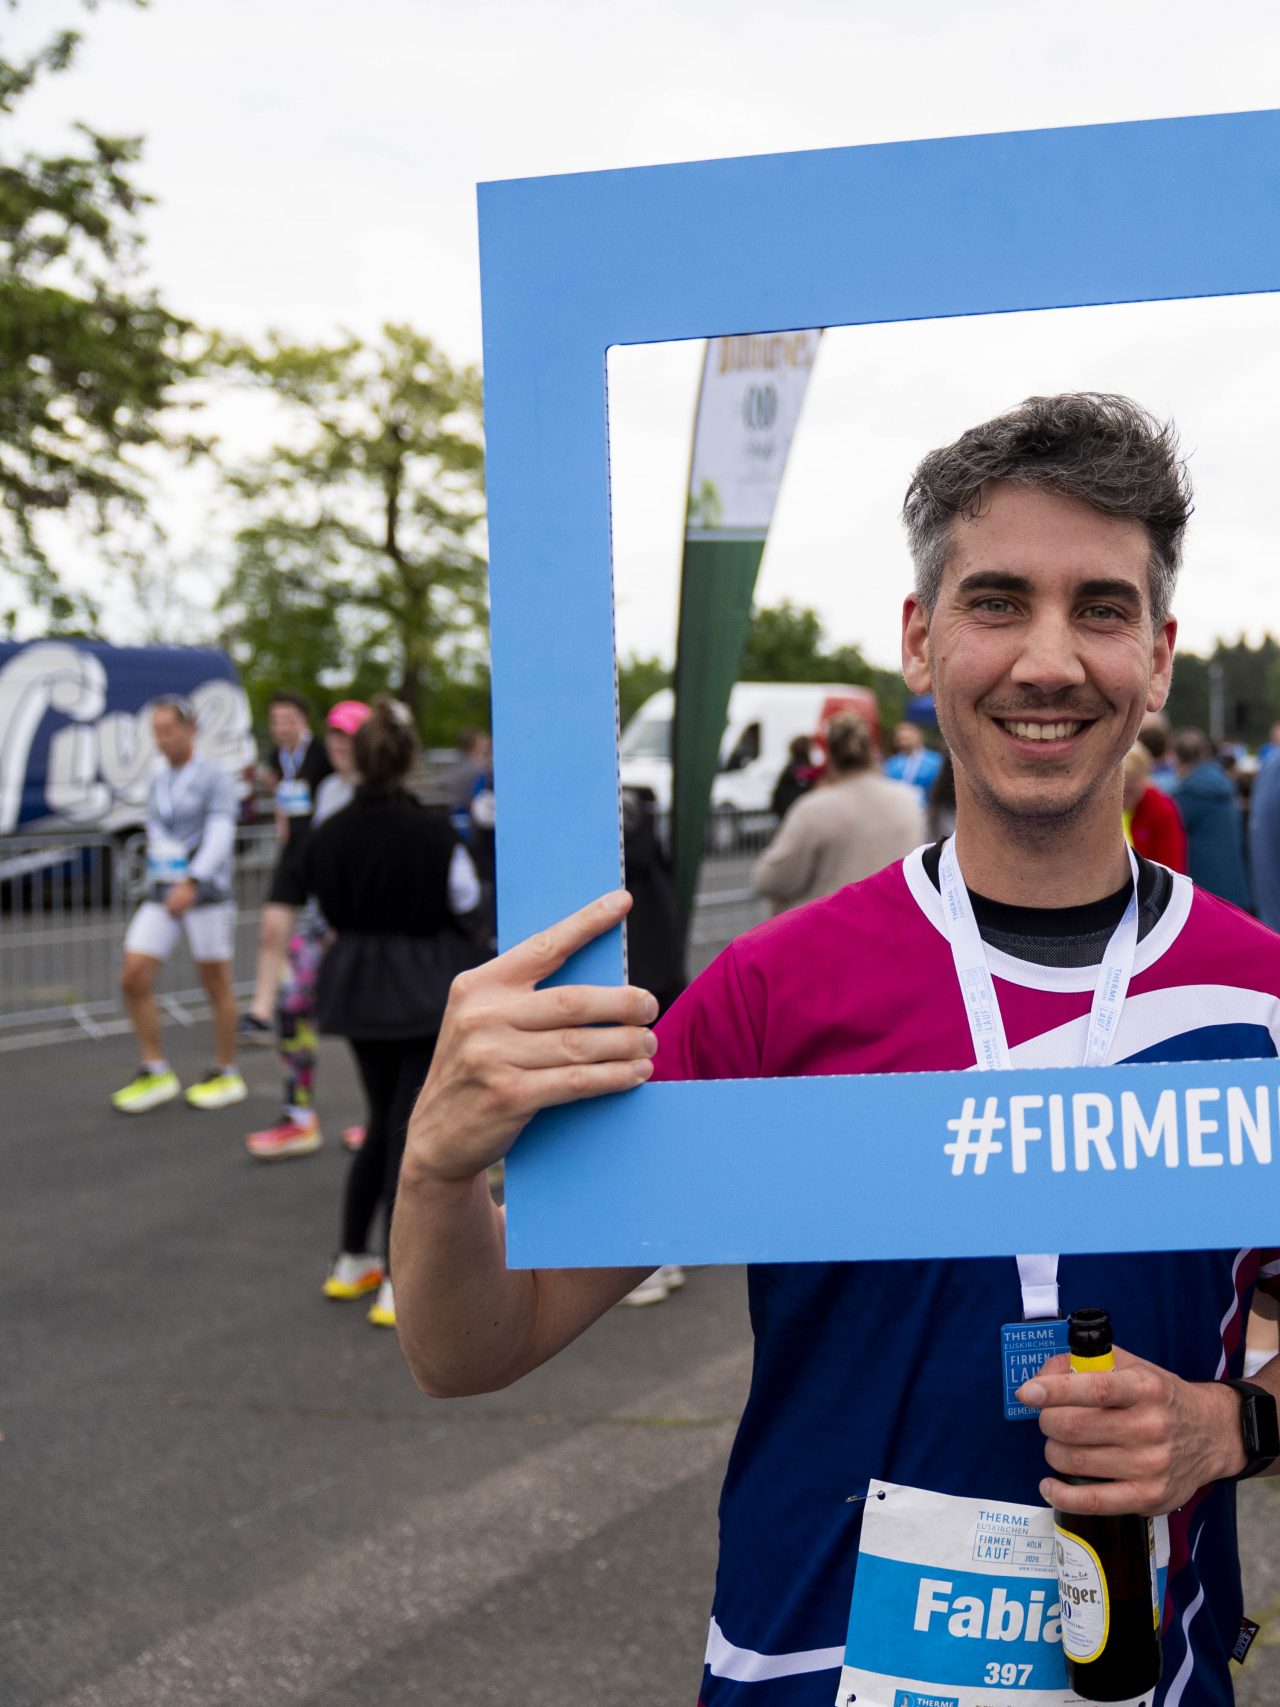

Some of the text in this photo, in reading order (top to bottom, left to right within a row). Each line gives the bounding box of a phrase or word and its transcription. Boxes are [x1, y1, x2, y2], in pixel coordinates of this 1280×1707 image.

[1108, 968, 1122, 1002] THERME
[981, 1010, 993, 1031] LAUF
[1097, 1007, 1107, 1029] LAUF
[1004, 1329, 1055, 1342] THERME
[1004, 1340, 1056, 1350] EUSKIRCHEN
[978, 1511, 1030, 1527] THERME
[976, 1522, 1029, 1536] EUSKIRCHEN
[979, 1535, 1012, 1547] FIRMEN
[1026, 1541, 1042, 1549] KÖLN
[977, 1545, 1010, 1560] LAUF
[983, 1662, 1034, 1686] 397
